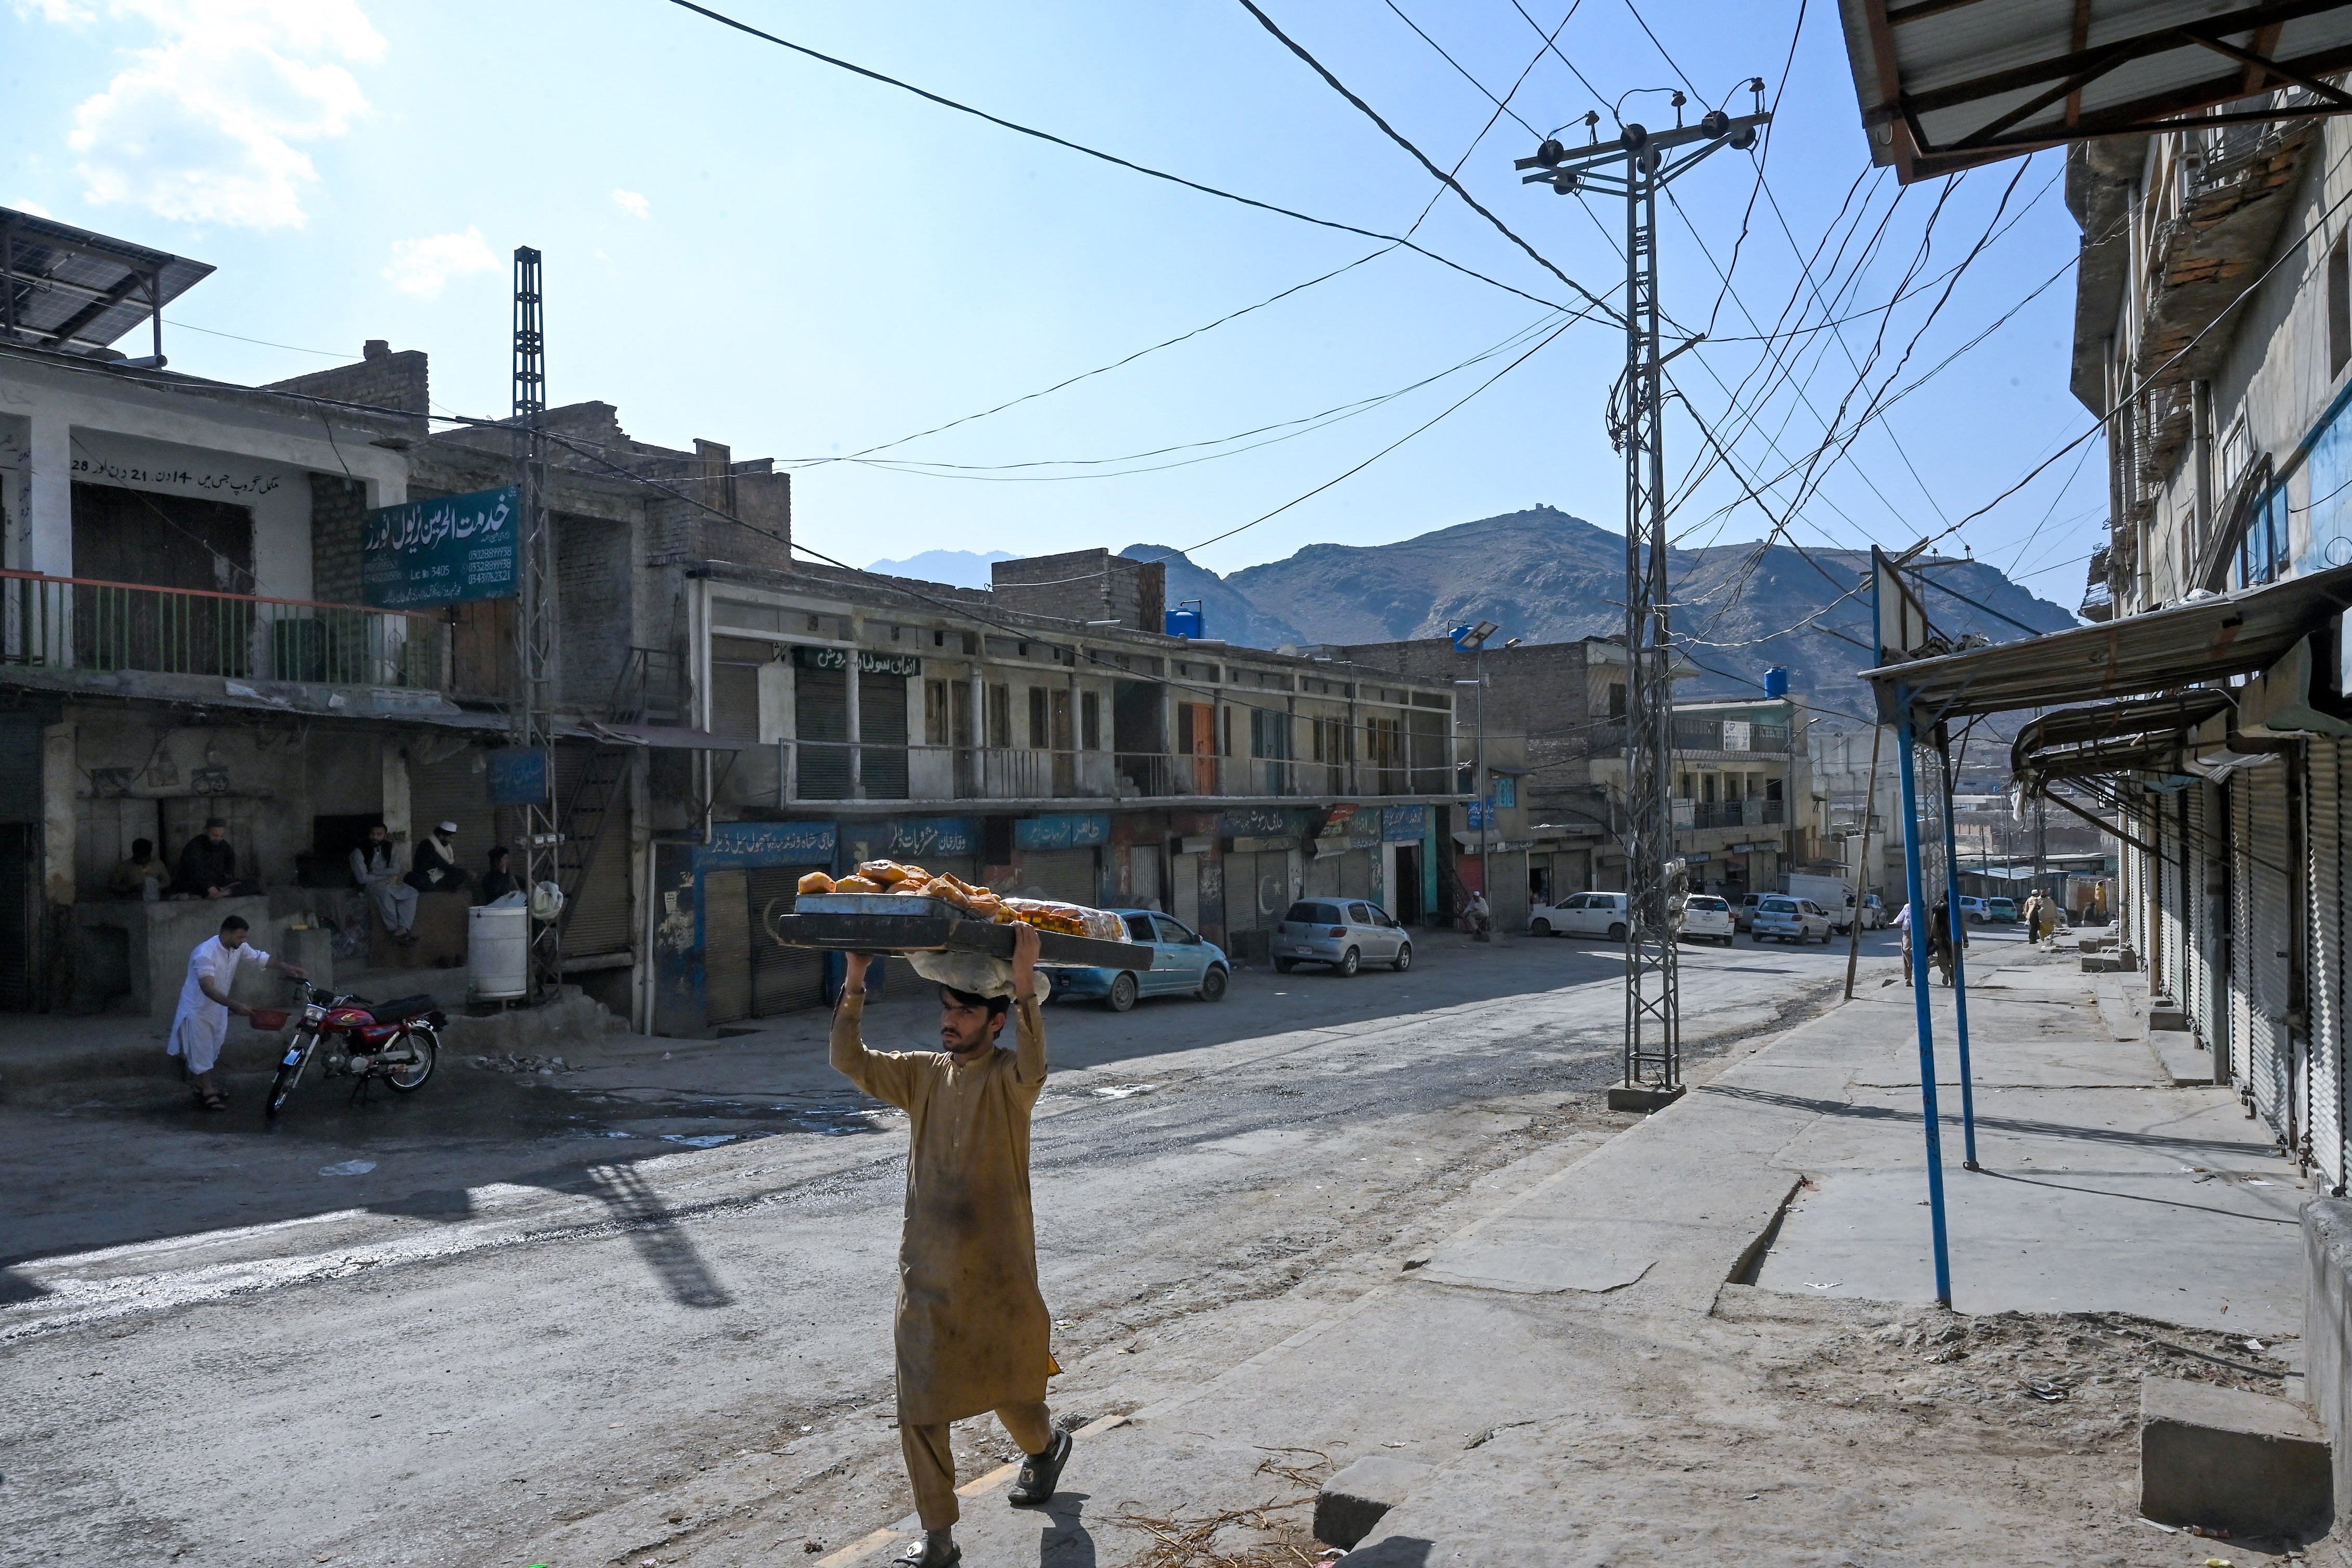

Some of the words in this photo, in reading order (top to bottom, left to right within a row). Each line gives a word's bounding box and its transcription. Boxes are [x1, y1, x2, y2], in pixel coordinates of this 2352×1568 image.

[72, 460, 88, 471] 28
[93, 460, 108, 474] اور
[109, 466, 126, 478] دن
[131, 470, 147, 481] 21
[173, 472, 192, 484] 14
[230, 476, 261, 496] گروپ
[456, 494, 511, 538] خدمت
[392, 504, 422, 554] ٹریول
[421, 503, 456, 550] الحرمین
[468, 546, 512, 560] 03028899938
[432, 565, 450, 577] 3405
[468, 558, 511, 572] 03328899938
[468, 570, 510, 584] 03439762321
[817, 649, 846, 669] روش
[1266, 809, 1283, 831] حاجی
[1073, 818, 1099, 842] طاہر
[711, 832, 730, 854] ڈیلر
[730, 832, 747, 855] سیل
[801, 831, 817, 850] شاہ
[818, 832, 835, 851] حاجی
[901, 826, 938, 856] مشروبات
[938, 832, 954, 851] خان
[951, 832, 966, 851] وقار
